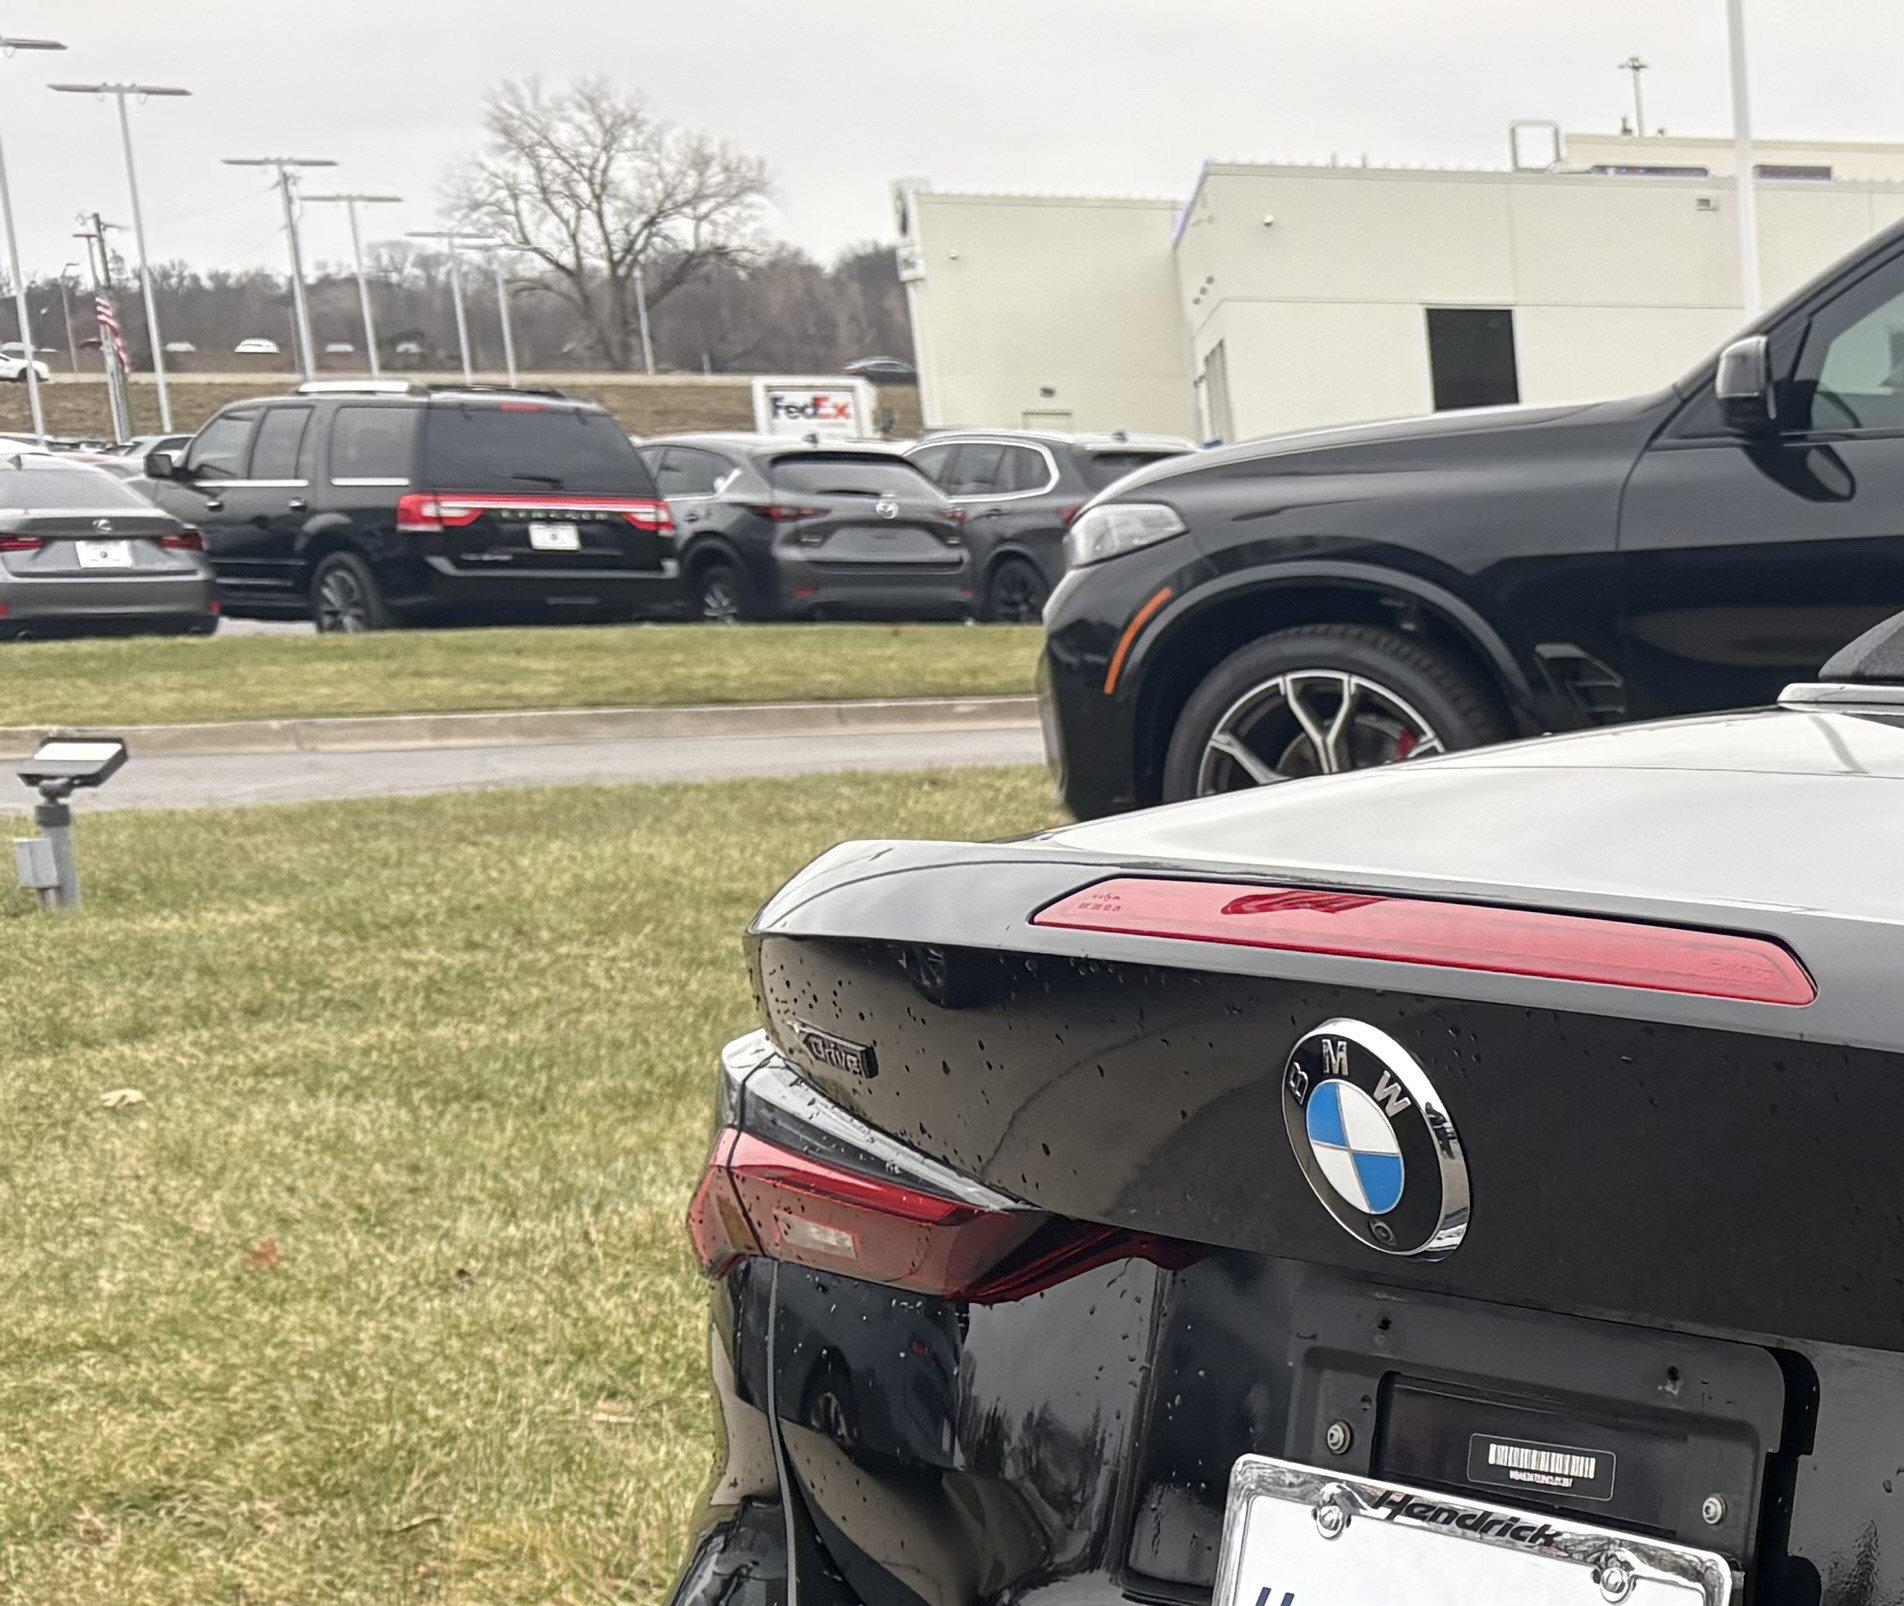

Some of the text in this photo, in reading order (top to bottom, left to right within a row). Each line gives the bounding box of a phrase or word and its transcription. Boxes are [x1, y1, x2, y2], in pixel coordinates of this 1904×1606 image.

[770, 395, 851, 419] FedEx
[1287, 1038, 1411, 1117] BMW
[1372, 1489, 1563, 1546] Hendrick
